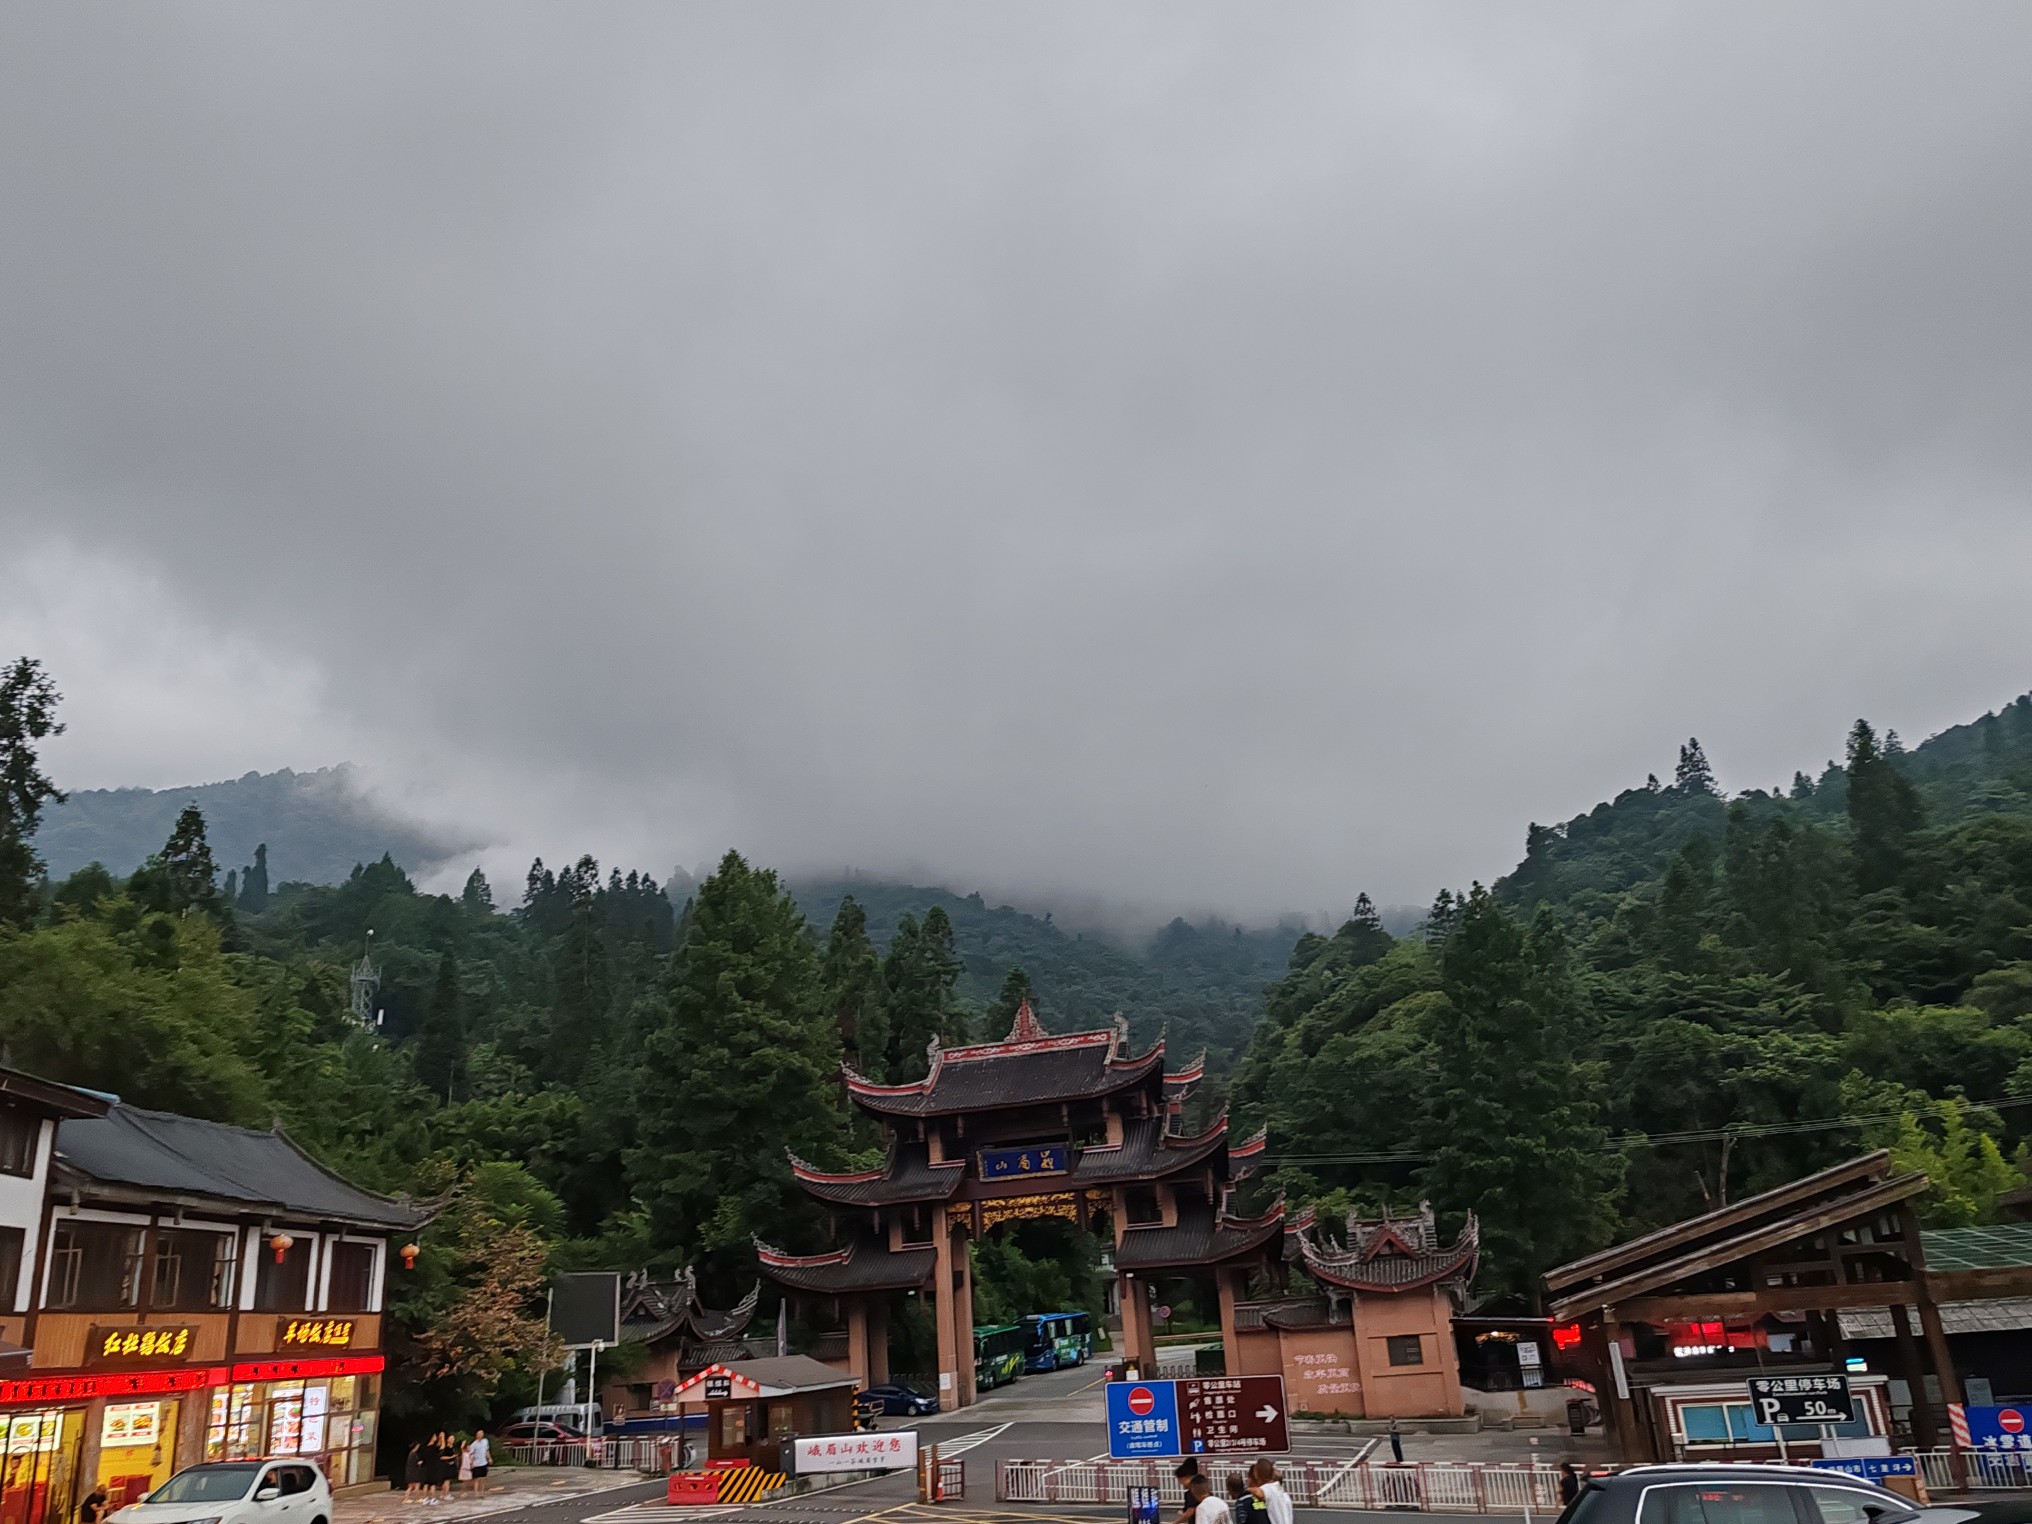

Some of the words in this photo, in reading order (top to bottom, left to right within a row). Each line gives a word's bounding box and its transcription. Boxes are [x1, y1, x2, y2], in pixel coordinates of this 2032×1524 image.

[1755, 1377, 1841, 1393] 零公里停车场
[1759, 1397, 1781, 1423] P
[1117, 1418, 1169, 1434] 交通管制
[807, 1437, 902, 1457] 峨眉山欢迎您
